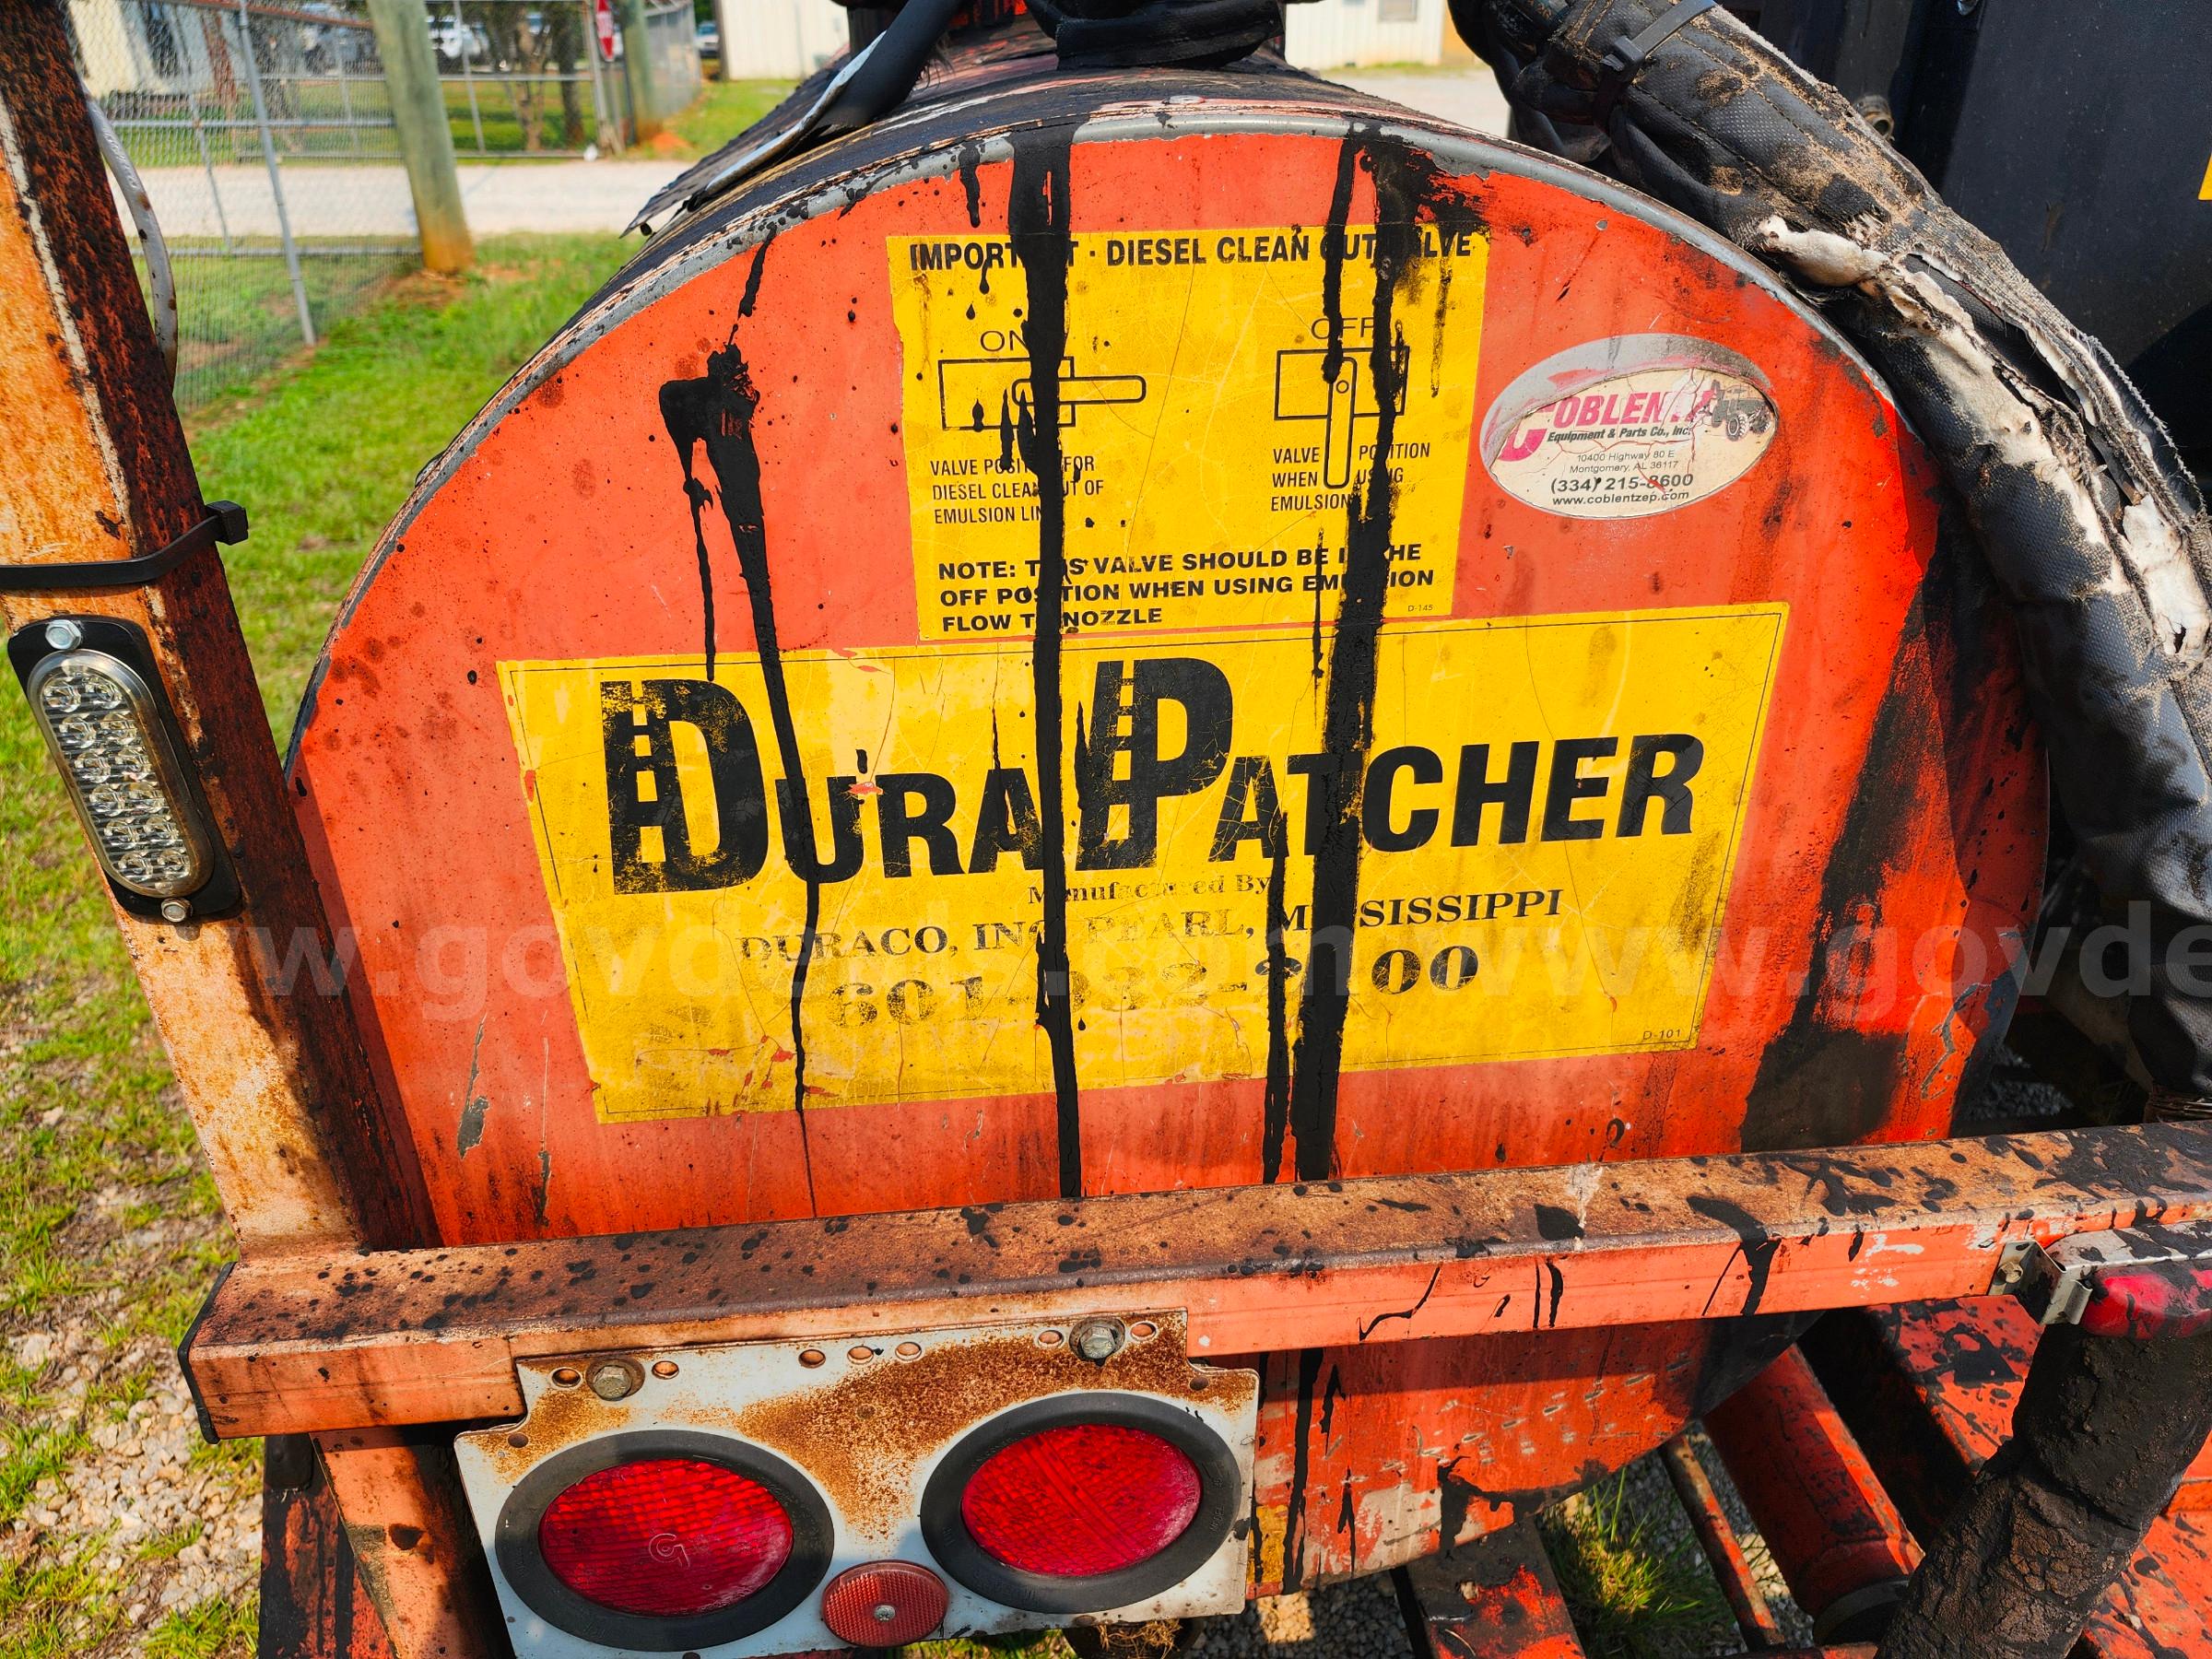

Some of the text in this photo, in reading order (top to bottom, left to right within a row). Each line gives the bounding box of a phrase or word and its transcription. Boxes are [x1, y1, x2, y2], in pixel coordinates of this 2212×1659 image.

[910, 241, 1079, 271] IMPORTT
[1107, 237, 1207, 266] DIESEL
[1217, 235, 1309, 263] CLEAN
[1547, 428, 1605, 444] Equipment
[1607, 429, 1616, 439] &
[1618, 426, 1647, 439] Parts
[1273, 442, 1430, 464] VALVE POITION
[1577, 449, 1675, 463] 10400 Highway 80 E
[930, 459, 978, 477] VALVE
[1570, 463, 1630, 475] Montgomery,
[1633, 462, 1646, 471] AL
[1272, 471, 1318, 488] WHEN
[1550, 477, 1598, 493] (334)
[932, 483, 986, 500] DIESEL
[1084, 478, 1104, 496] OF
[1552, 490, 1689, 505] www.coblentzep.com
[1271, 494, 1352, 512] EMULSION
[935, 506, 1016, 524] EMULSION
[938, 560, 1016, 581] NOTE:
[1024, 558, 1085, 577] TS
[1093, 554, 1173, 574] VALVE
[1182, 549, 1288, 571] SHOULD
[1296, 547, 1329, 566] BE
[1388, 544, 1422, 561] HE
[940, 570, 1434, 607] OFF POTION WHEN USING EMION
[1407, 604, 1433, 613] D-145
[943, 614, 1011, 632] FLOW
[1063, 607, 1162, 628] NOZZLE
[735, 924, 959, 963] DURACO,
[1276, 889, 1562, 932] MSISSIPPI
[1642, 1029, 1681, 1041] D-101
